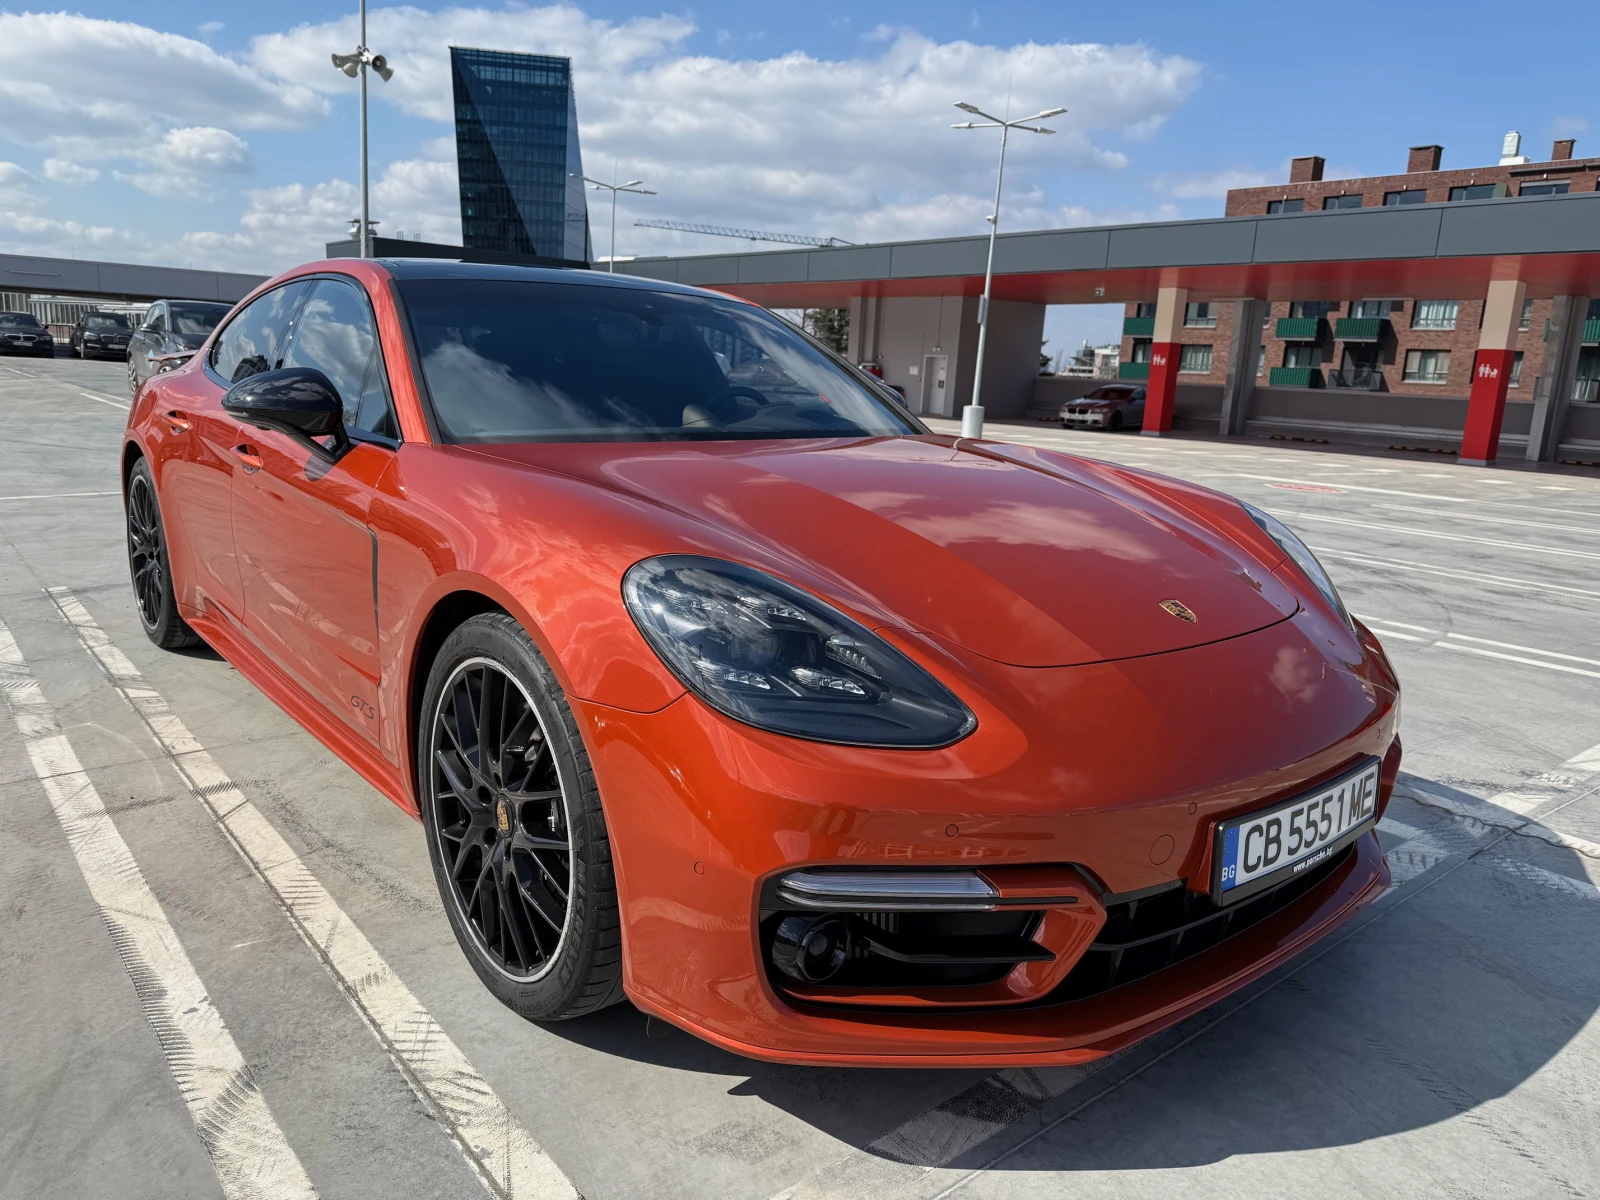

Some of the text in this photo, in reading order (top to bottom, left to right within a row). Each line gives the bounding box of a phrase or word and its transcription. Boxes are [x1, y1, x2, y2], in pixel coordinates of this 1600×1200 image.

[350, 695, 376, 720] GTS
[1243, 772, 1375, 874] CB 5551 ME
[1221, 864, 1236, 882] BG
[560, 857, 587, 988] MICHELIN
